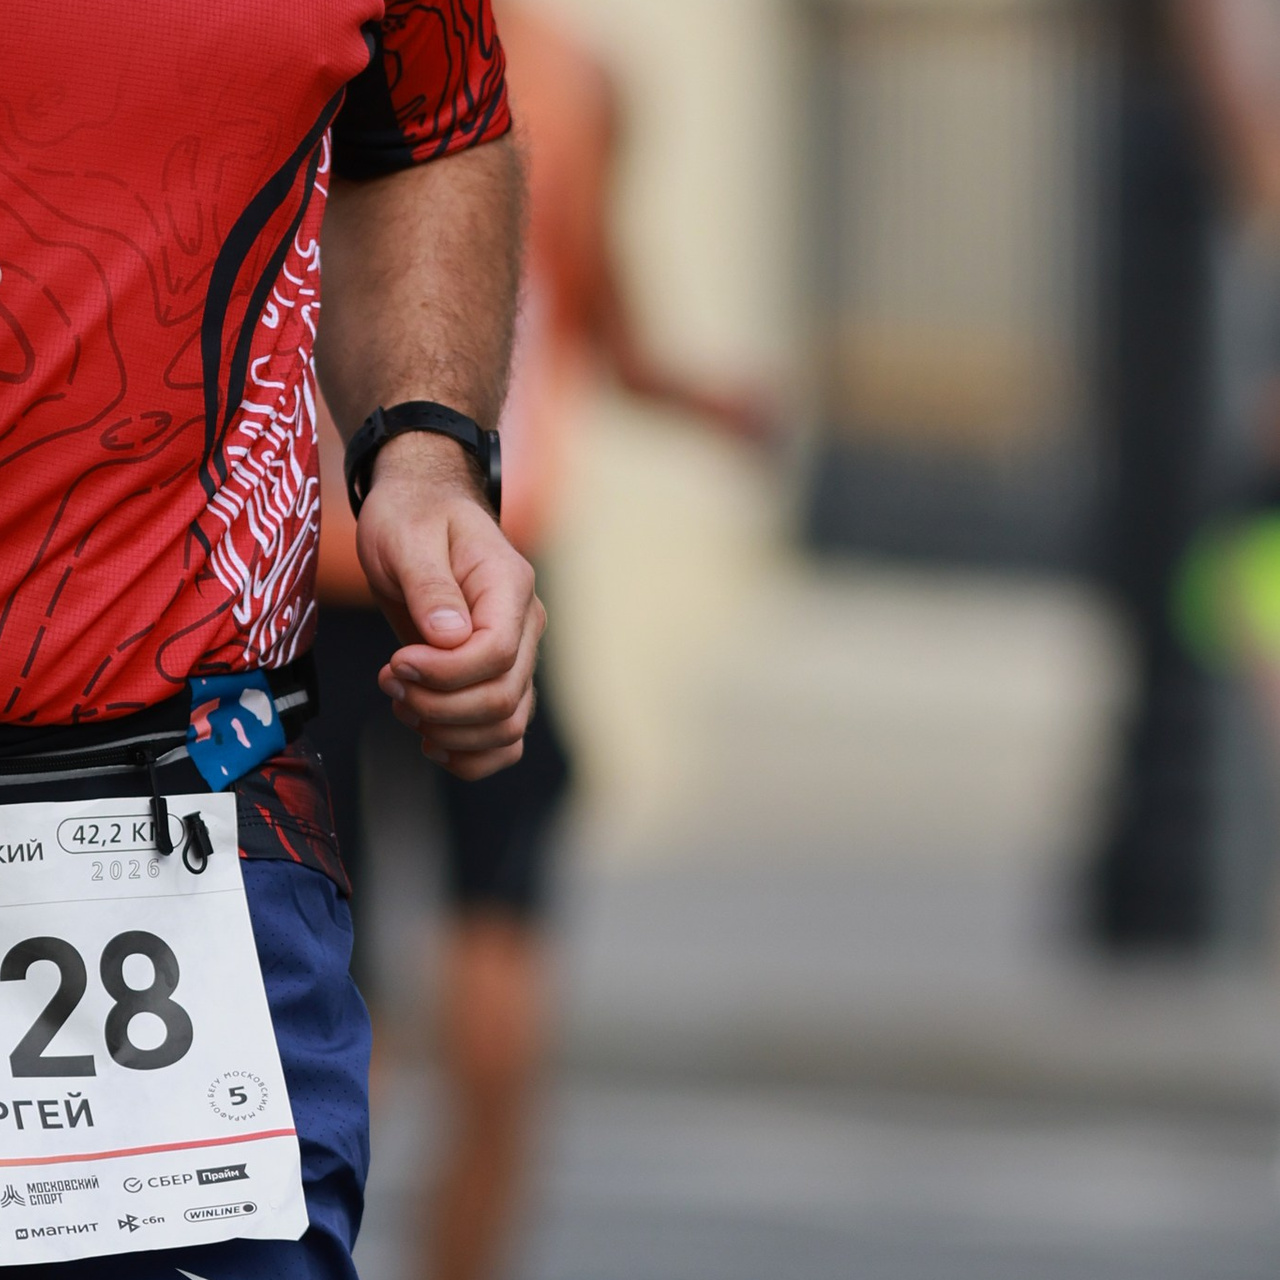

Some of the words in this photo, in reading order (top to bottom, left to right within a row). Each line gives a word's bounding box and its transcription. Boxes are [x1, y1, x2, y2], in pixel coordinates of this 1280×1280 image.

[72, 822, 122, 847] 42,2
[91, 858, 161, 881] 2026
[207, 1077, 221, 1098] БЕГУ
[228, 1085, 248, 1106] 5
[26, 1175, 100, 1194] МОСКОВСКИЙ
[147, 1173, 193, 1188] СБЕР
[201, 1168, 240, 1182] Прайм
[29, 1192, 63, 1206] СПОРТ
[142, 1215, 165, 1225] сбп
[189, 1205, 241, 1220] WINLINE
